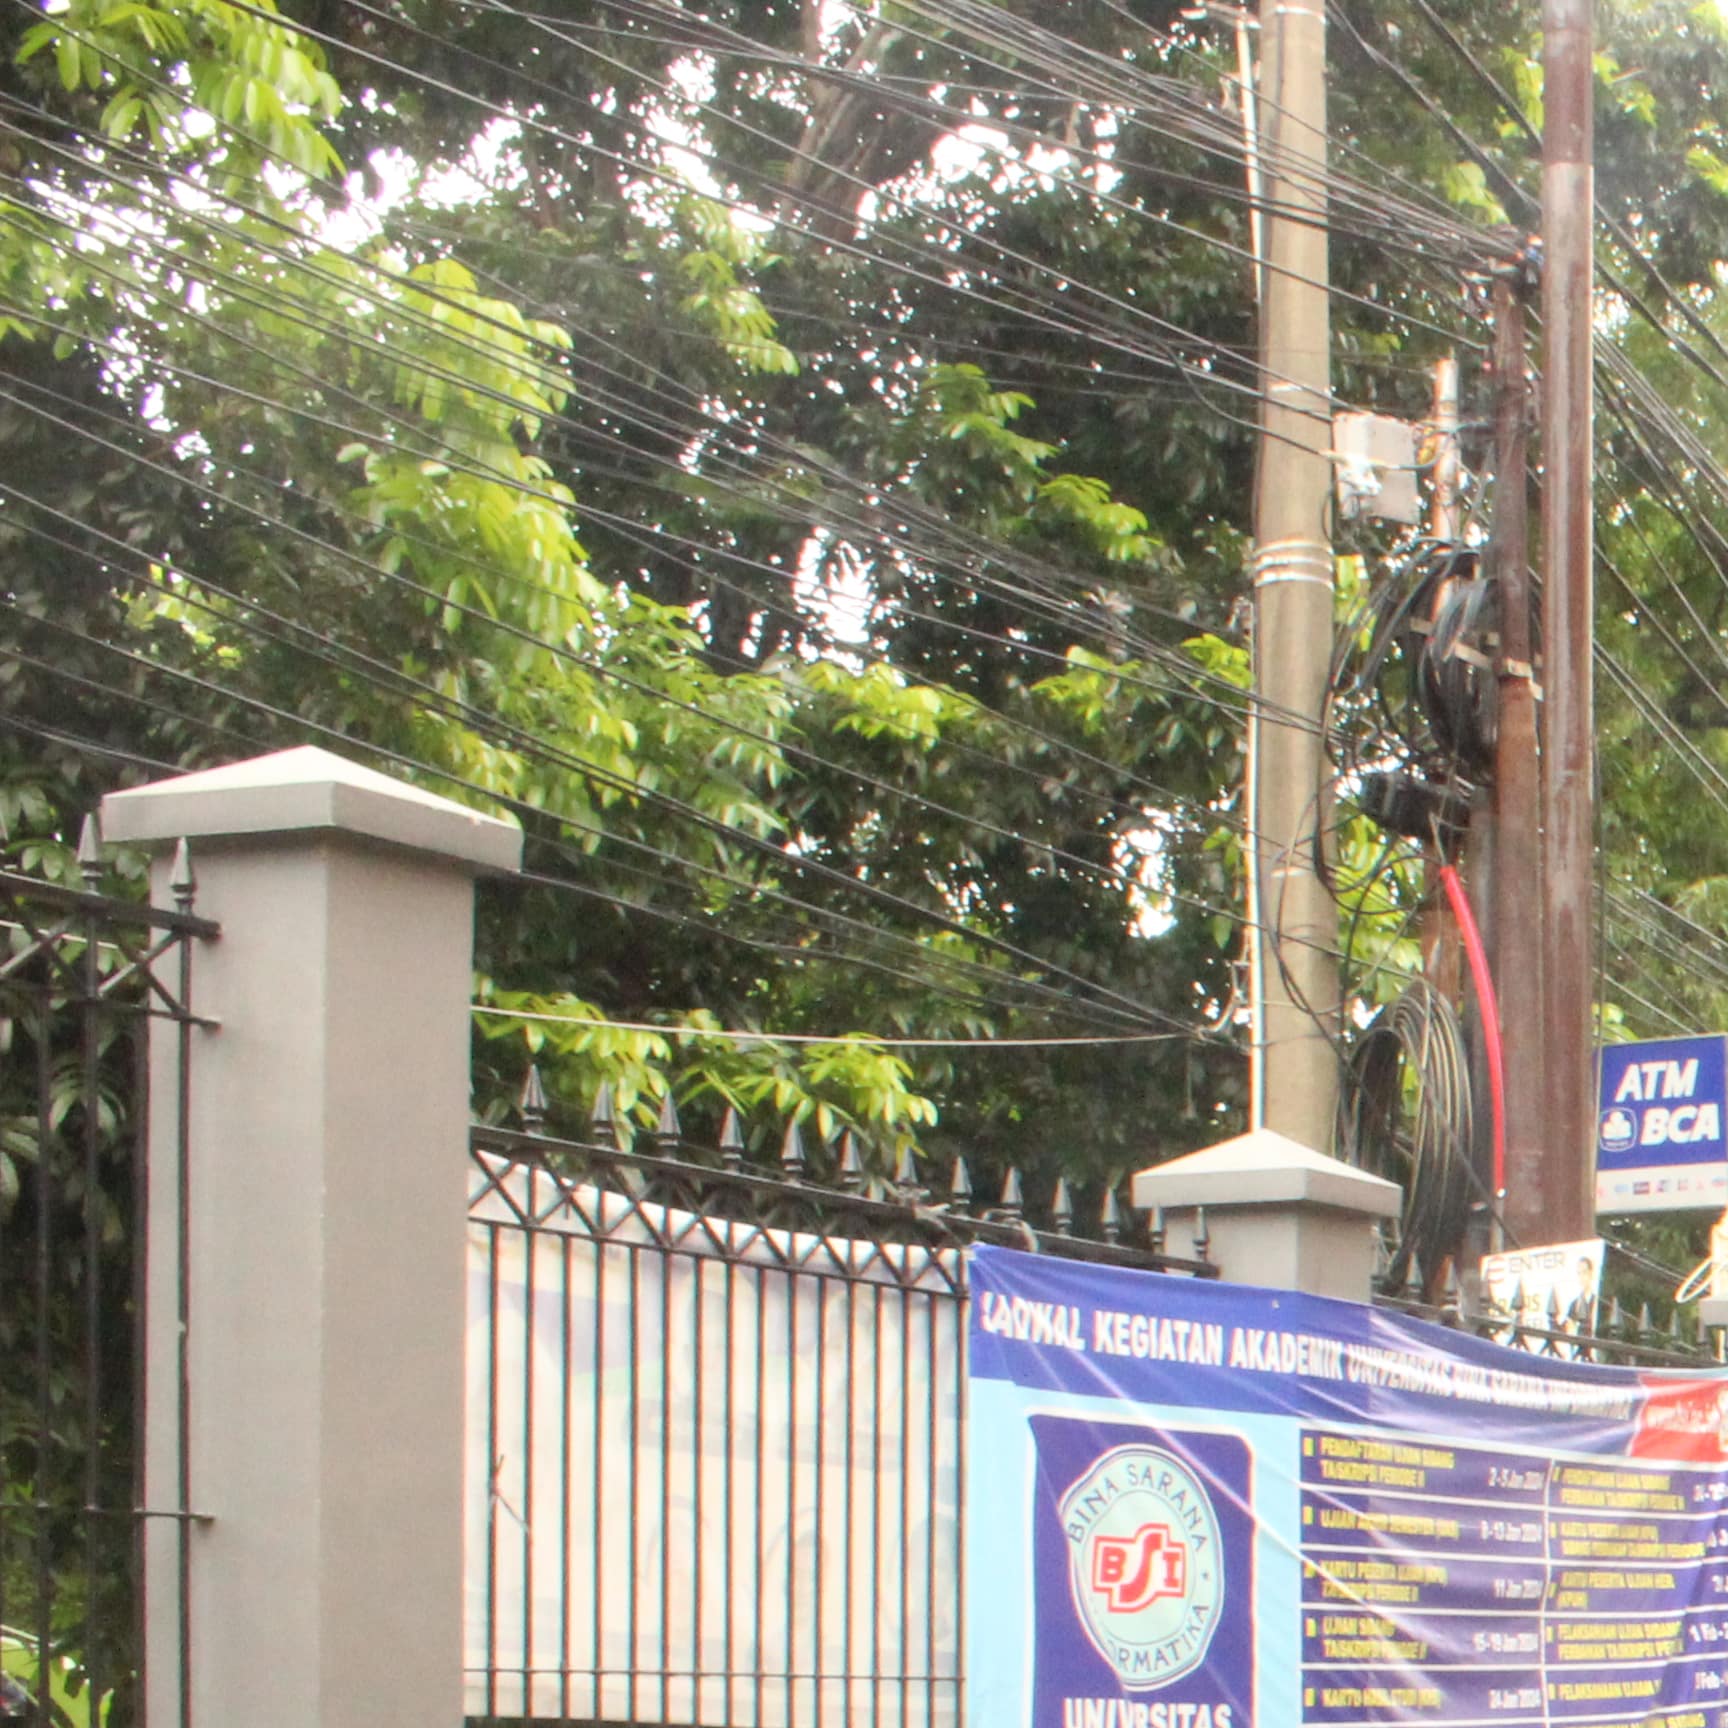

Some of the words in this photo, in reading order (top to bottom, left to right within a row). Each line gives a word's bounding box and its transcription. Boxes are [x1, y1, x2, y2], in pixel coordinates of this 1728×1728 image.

[1615, 1058, 1699, 1104] ATM
[1641, 1104, 1721, 1146] BCA
[1094, 1310, 1224, 1368] KEGIATAN
[1230, 1327, 1344, 1381] AKADEMIK
[1068, 1479, 1120, 1544] BINA
[1127, 1462, 1208, 1553] SARANA
[1099, 1531, 1183, 1604] BSI
